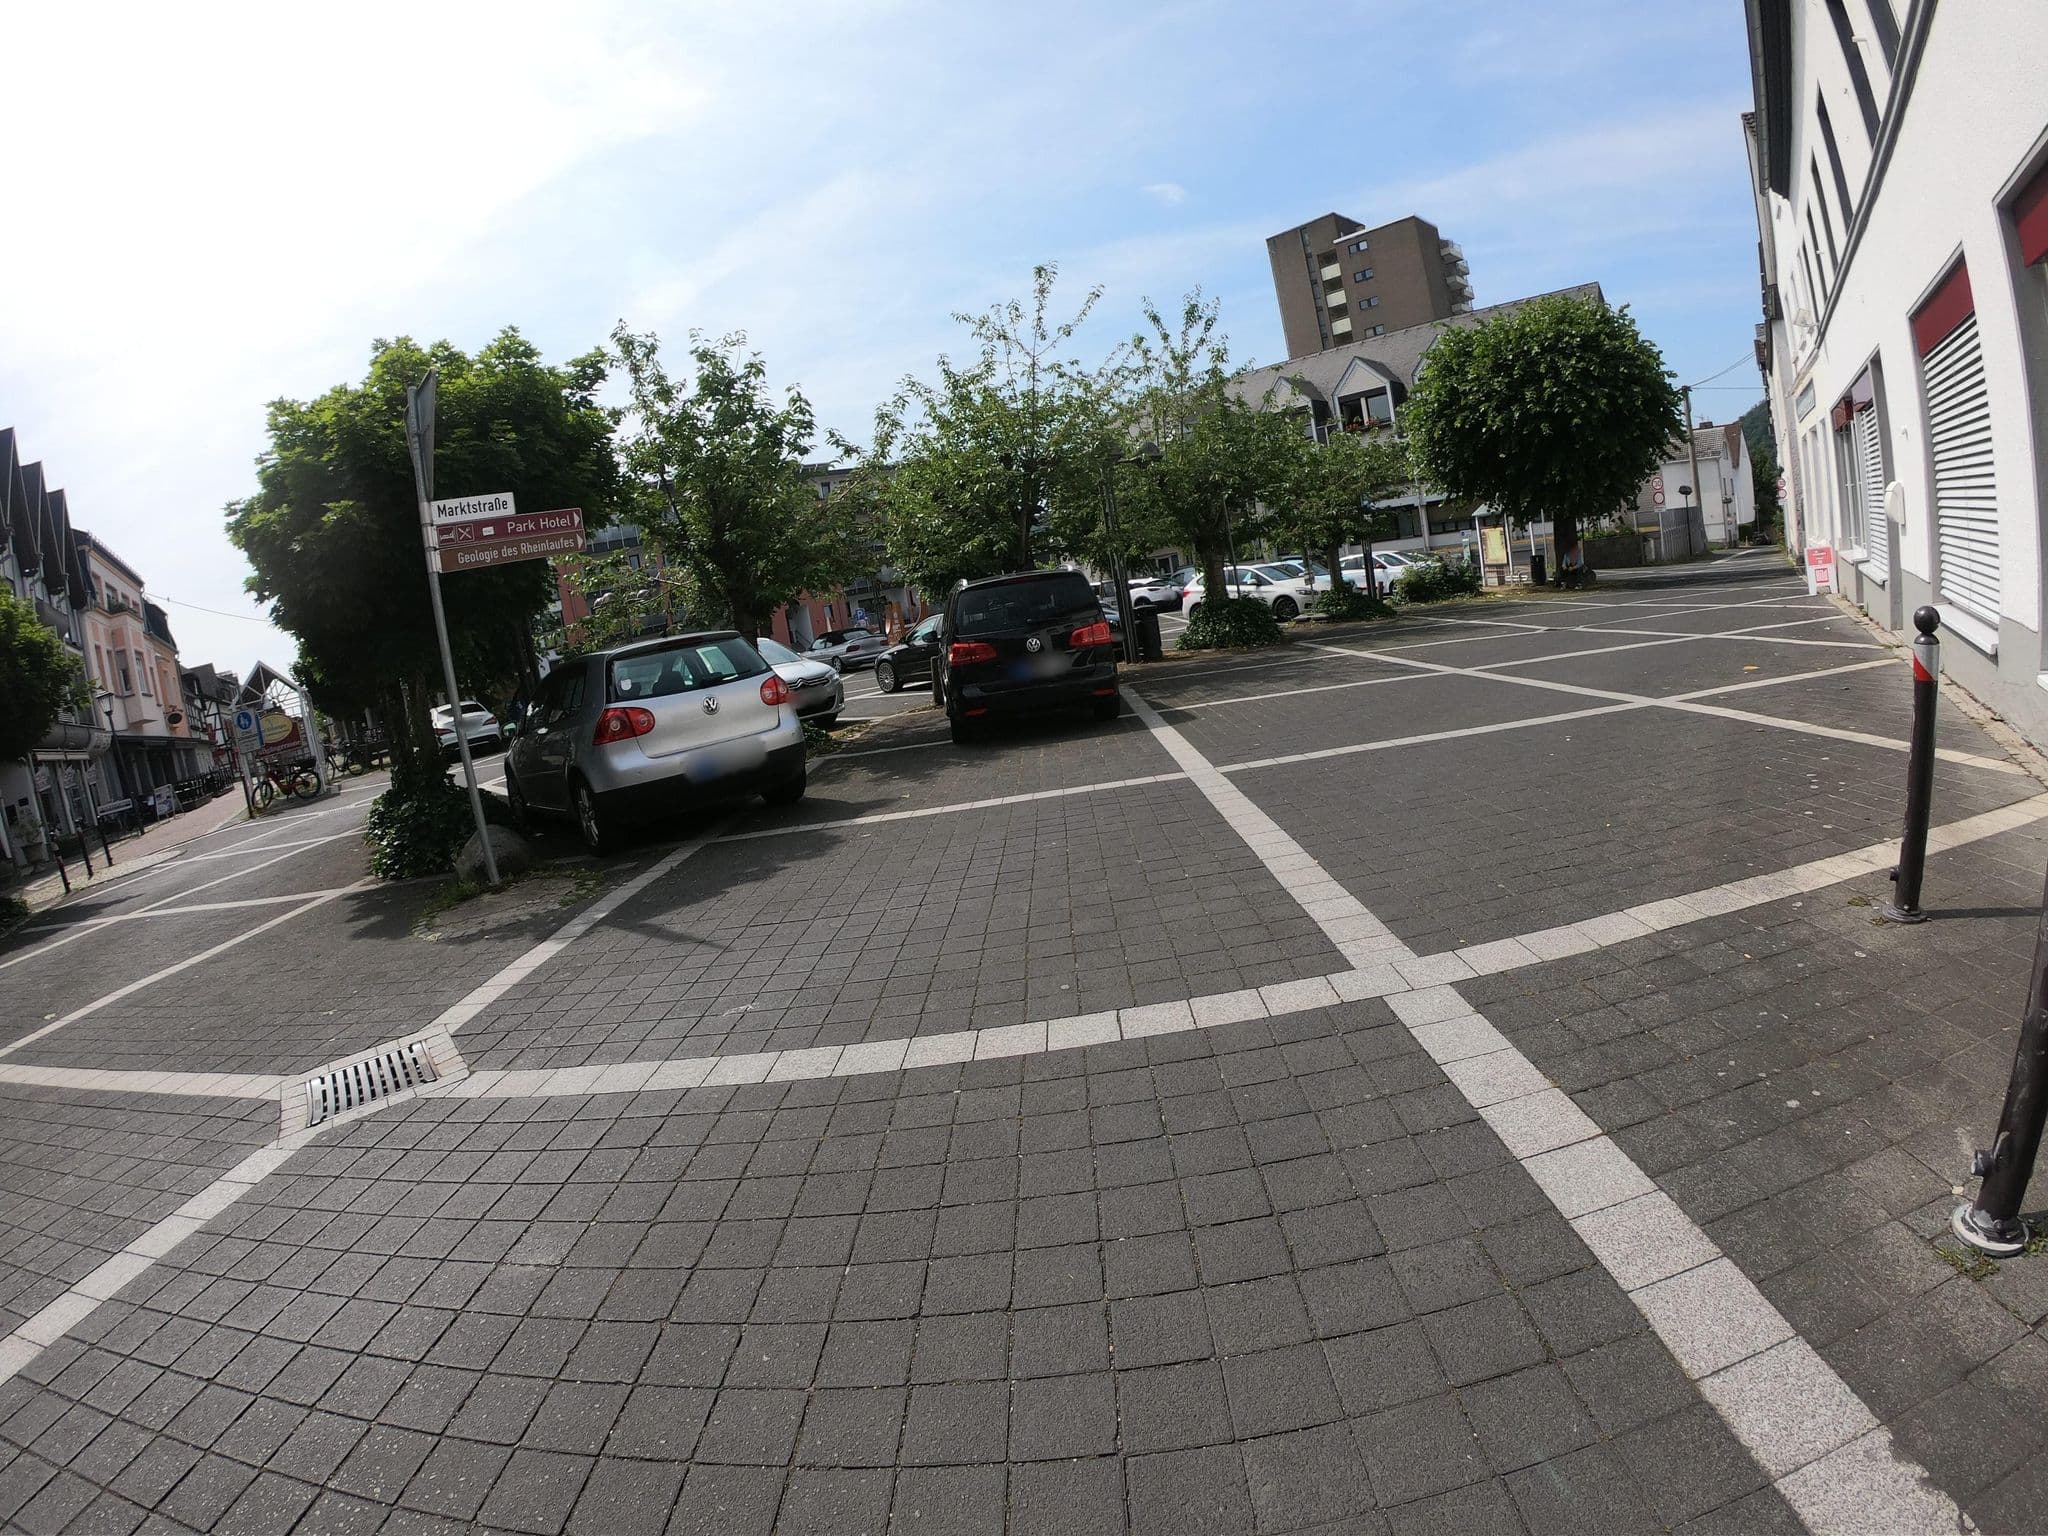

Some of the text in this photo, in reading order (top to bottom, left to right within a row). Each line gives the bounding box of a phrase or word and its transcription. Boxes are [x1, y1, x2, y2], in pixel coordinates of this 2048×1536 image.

[437, 497, 508, 518] Marktstraße
[507, 520, 536, 534] Park
[540, 515, 571, 529] Hotel
[457, 538, 574, 564] Geologie des Rheinlaufes
